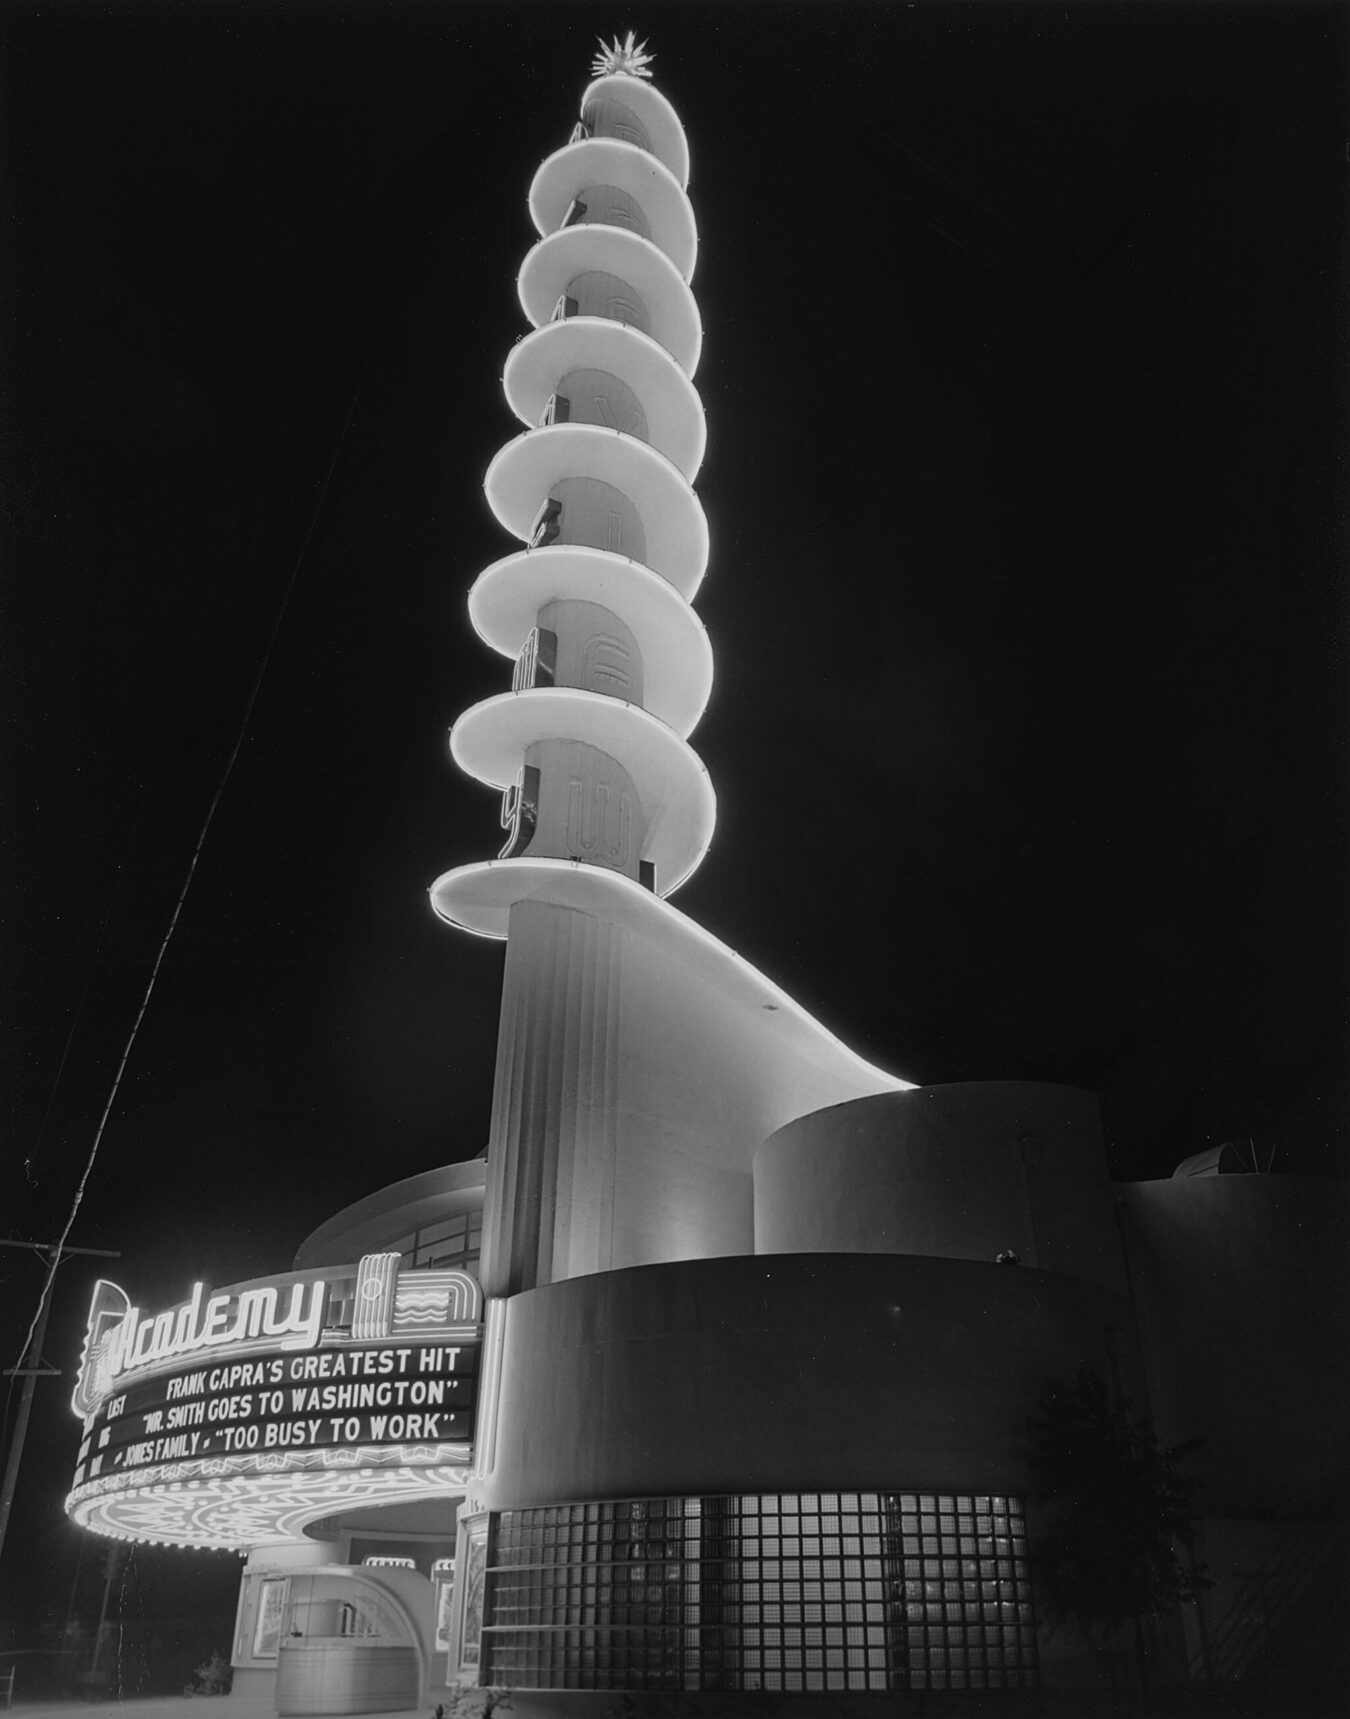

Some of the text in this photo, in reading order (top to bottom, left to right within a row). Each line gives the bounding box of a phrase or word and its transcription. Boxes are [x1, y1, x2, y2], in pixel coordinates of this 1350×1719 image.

[110, 1281, 325, 1376] Academy
[166, 1347, 461, 1401] FRANK CAPRA'S GREATEST HIT
[166, 1401, 206, 1429] SMITH
[208, 1394, 253, 1421] GOES
[258, 1390, 284, 1415] TO
[292, 1380, 458, 1412] WASHINGTON”
[155, 1431, 201, 1461] FAMILY
[215, 1425, 259, 1451] “TOO
[264, 1418, 322, 1447] BUSY
[330, 1416, 360, 1443] TO
[370, 1413, 455, 1441] WORK”
